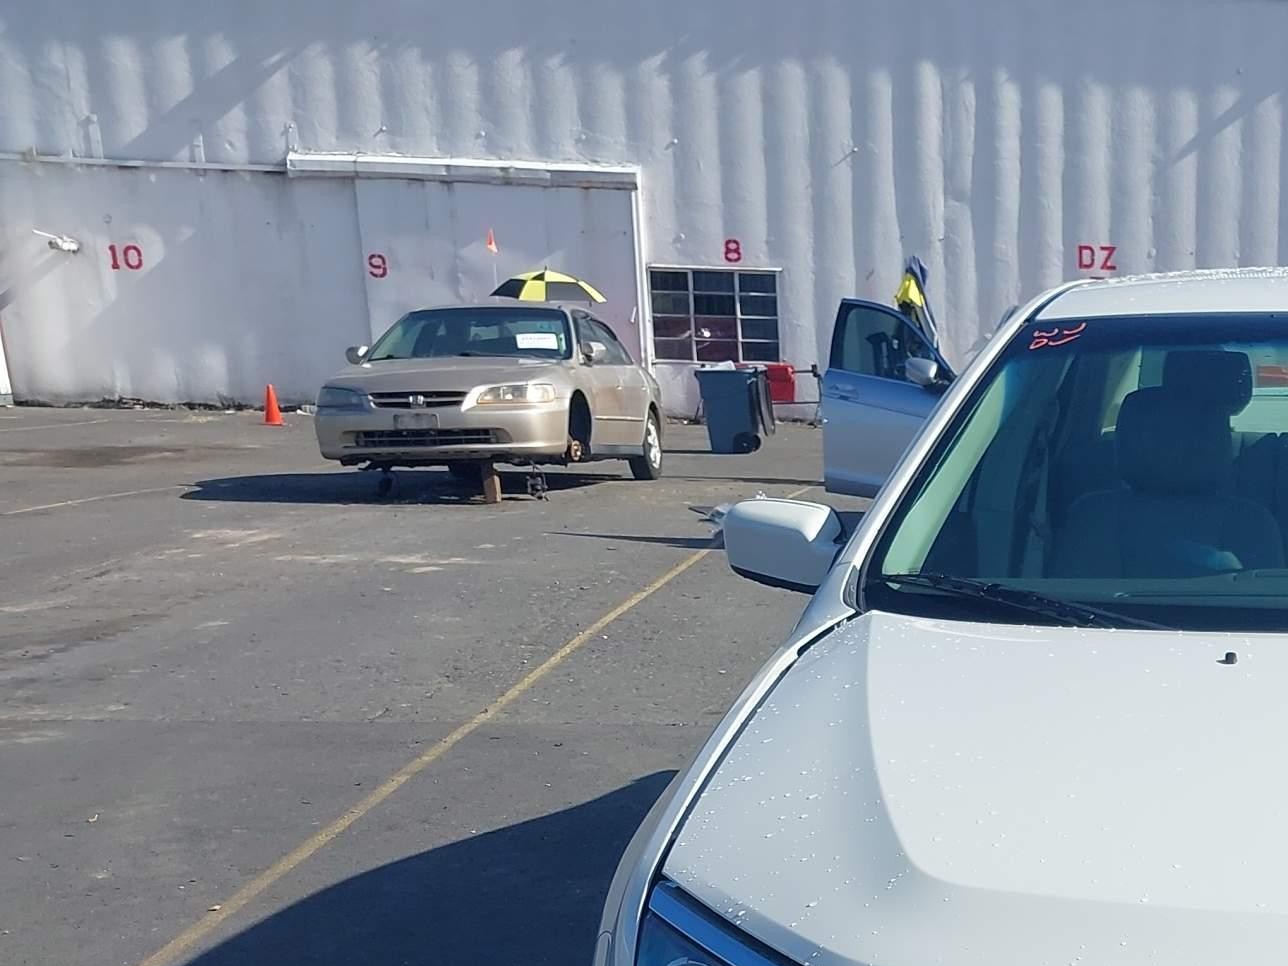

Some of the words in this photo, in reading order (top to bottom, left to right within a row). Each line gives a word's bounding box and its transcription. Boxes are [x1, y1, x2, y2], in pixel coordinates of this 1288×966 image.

[108, 244, 143, 270] 10
[724, 239, 742, 263] 8
[1078, 245, 1117, 271] DZ
[368, 254, 387, 279] 9
